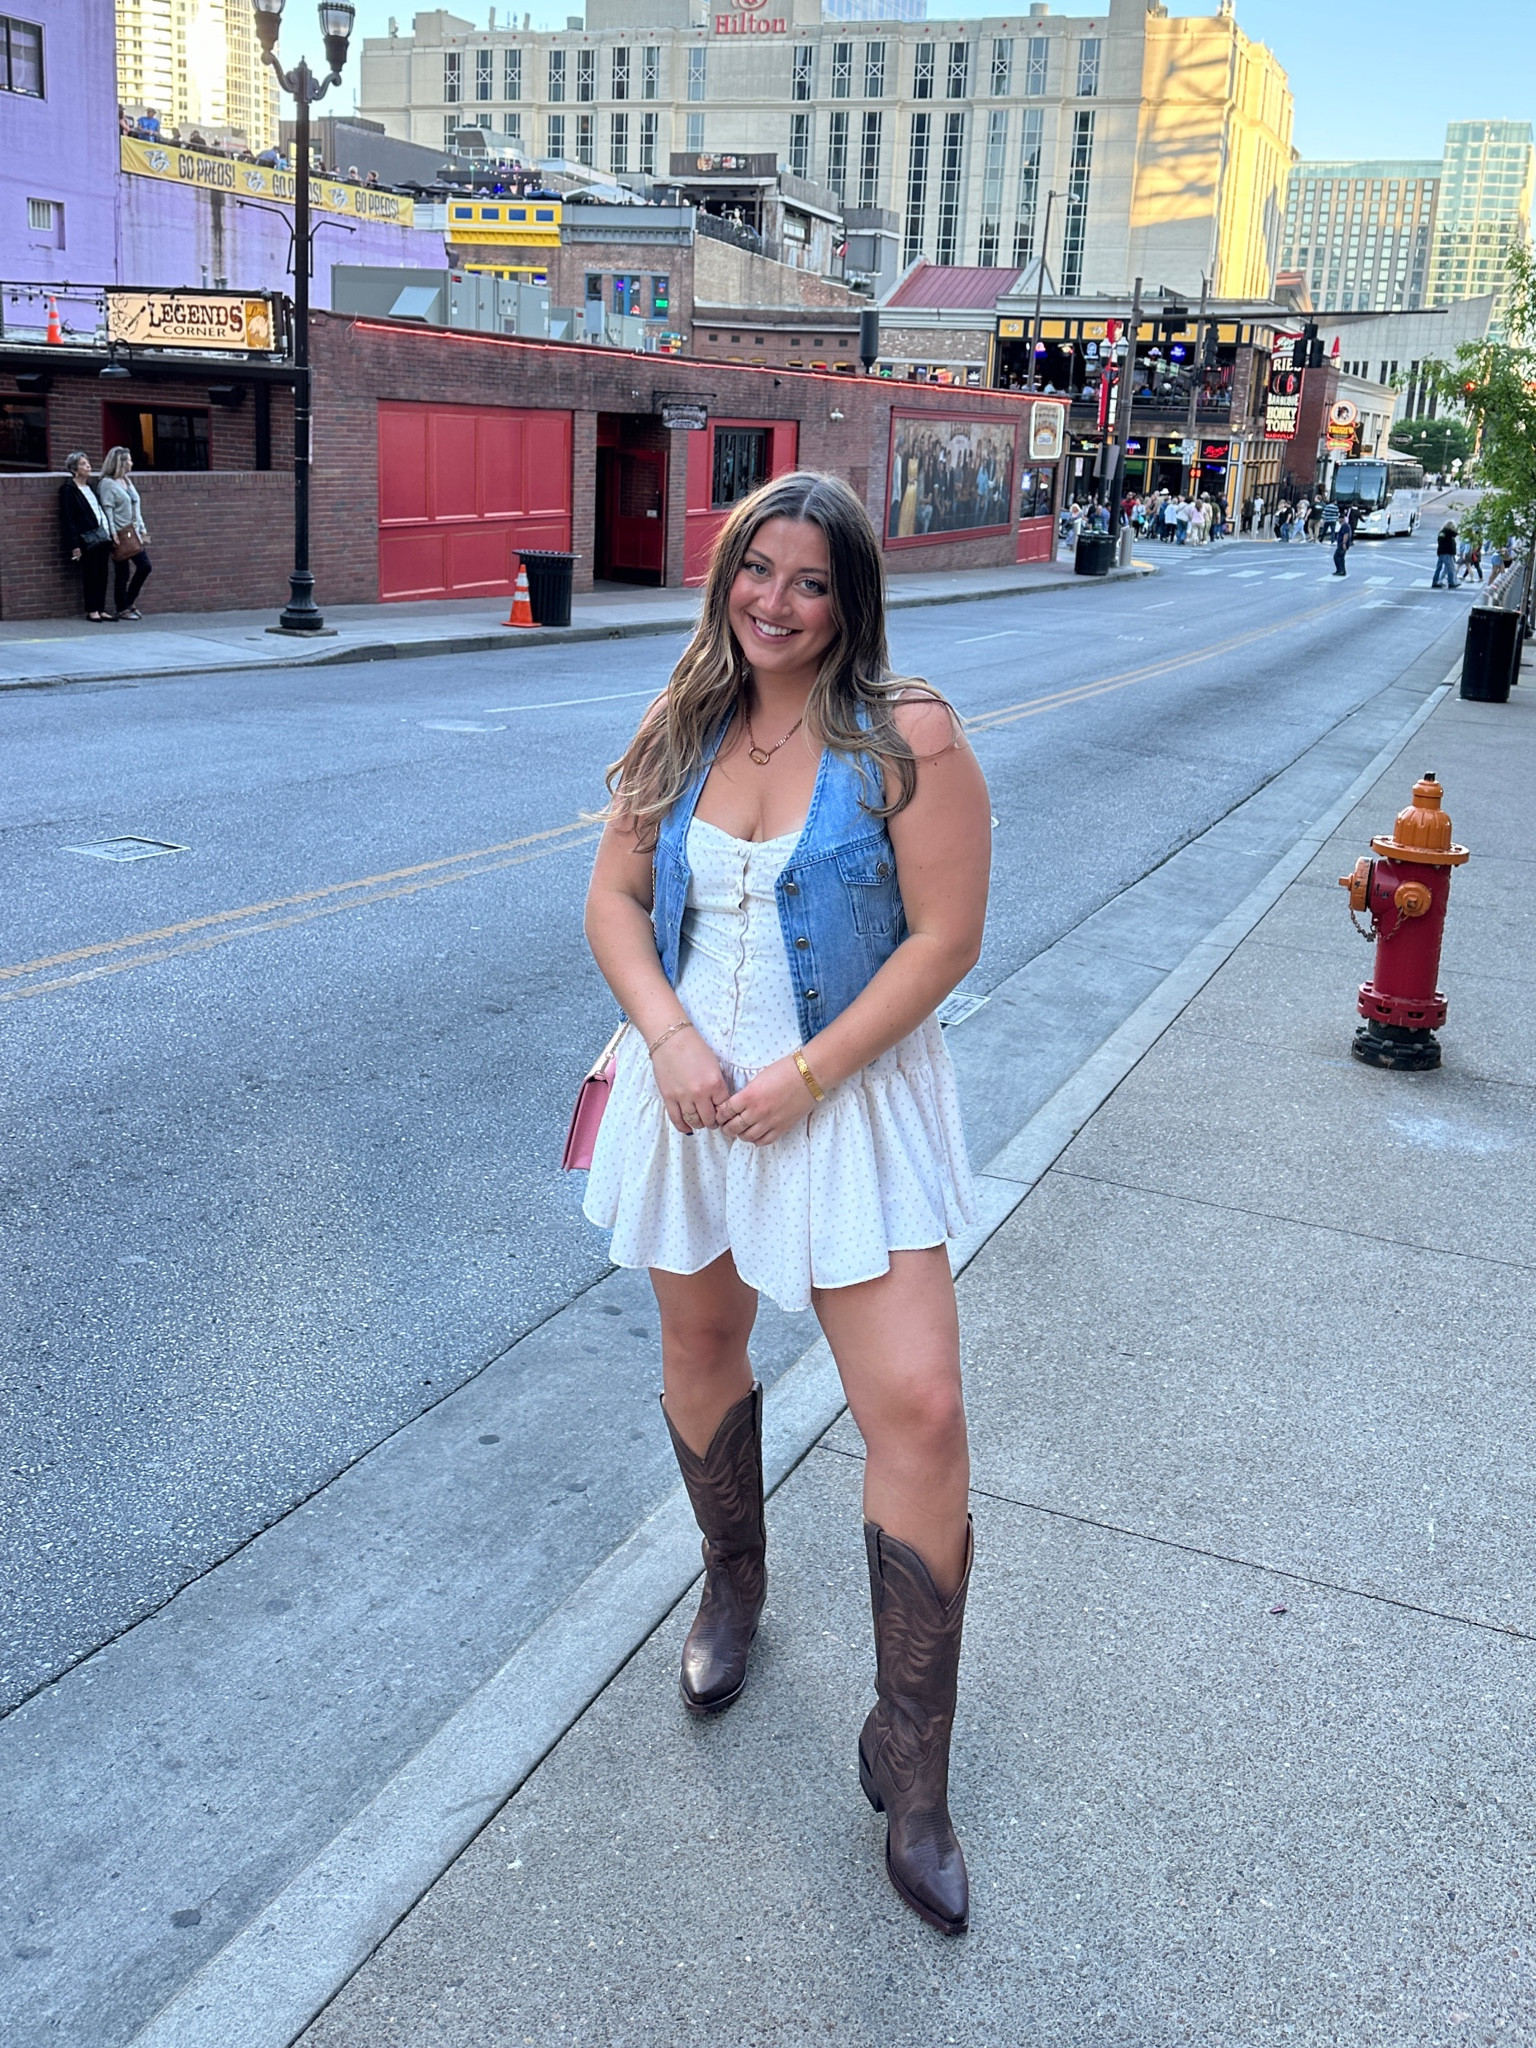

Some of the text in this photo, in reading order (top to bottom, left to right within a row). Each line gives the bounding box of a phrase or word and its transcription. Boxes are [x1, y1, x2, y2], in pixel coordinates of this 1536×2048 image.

[715, 11, 787, 35] Hilton
[178, 153, 236, 189] GO PREDS!
[272, 173, 287, 199] GO
[355, 190, 400, 220] GO PREDS!
[148, 300, 243, 333] LEGENDS
[163, 324, 226, 338] CORNER
[1266, 406, 1298, 420] HONKY
[1265, 419, 1296, 433] TONK
